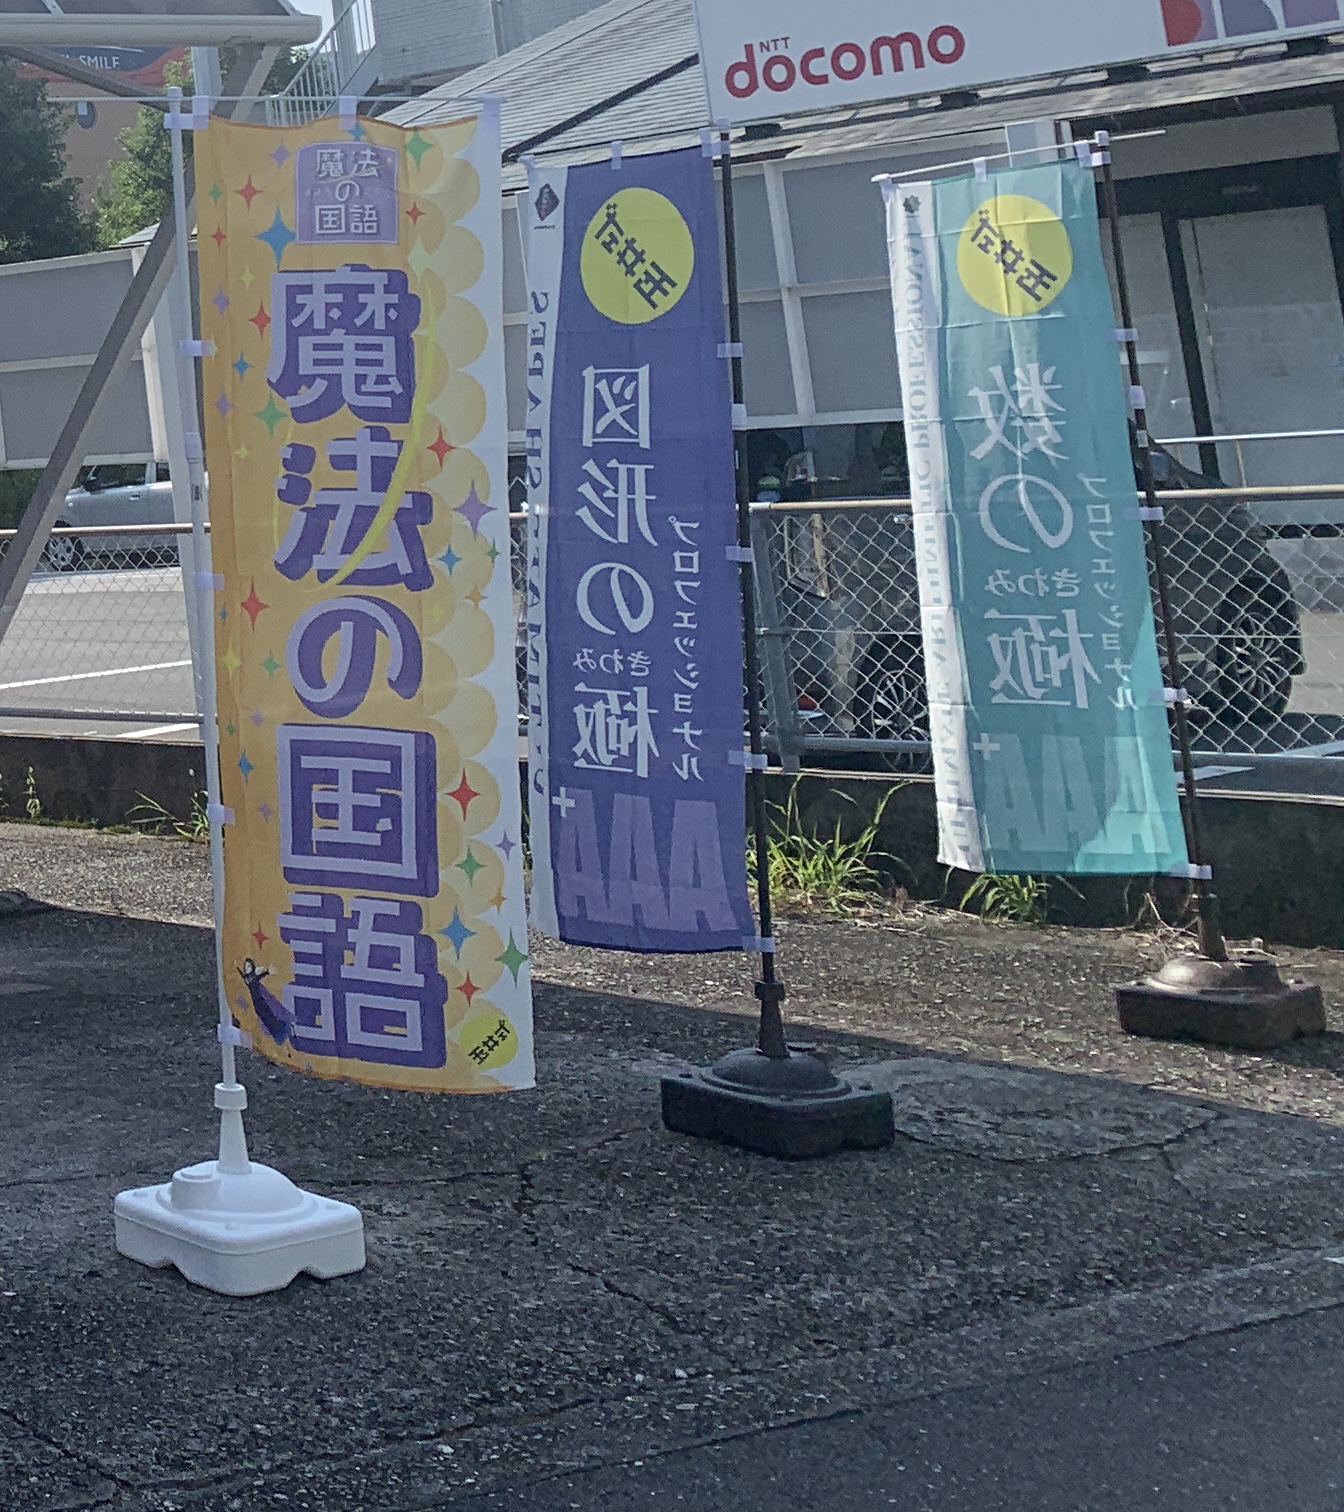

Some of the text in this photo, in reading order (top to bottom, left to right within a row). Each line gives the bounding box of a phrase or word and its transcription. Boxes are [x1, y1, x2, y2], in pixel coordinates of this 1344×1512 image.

[759, 36, 791, 54] NTT
[79, 54, 121, 70] SMILE
[724, 24, 967, 99] docomo
[316, 148, 379, 178] 魔法
[315, 204, 378, 235] 国語
[269, 264, 446, 1068] 魔法の国語
[467, 1018, 512, 1067] 玉井式
